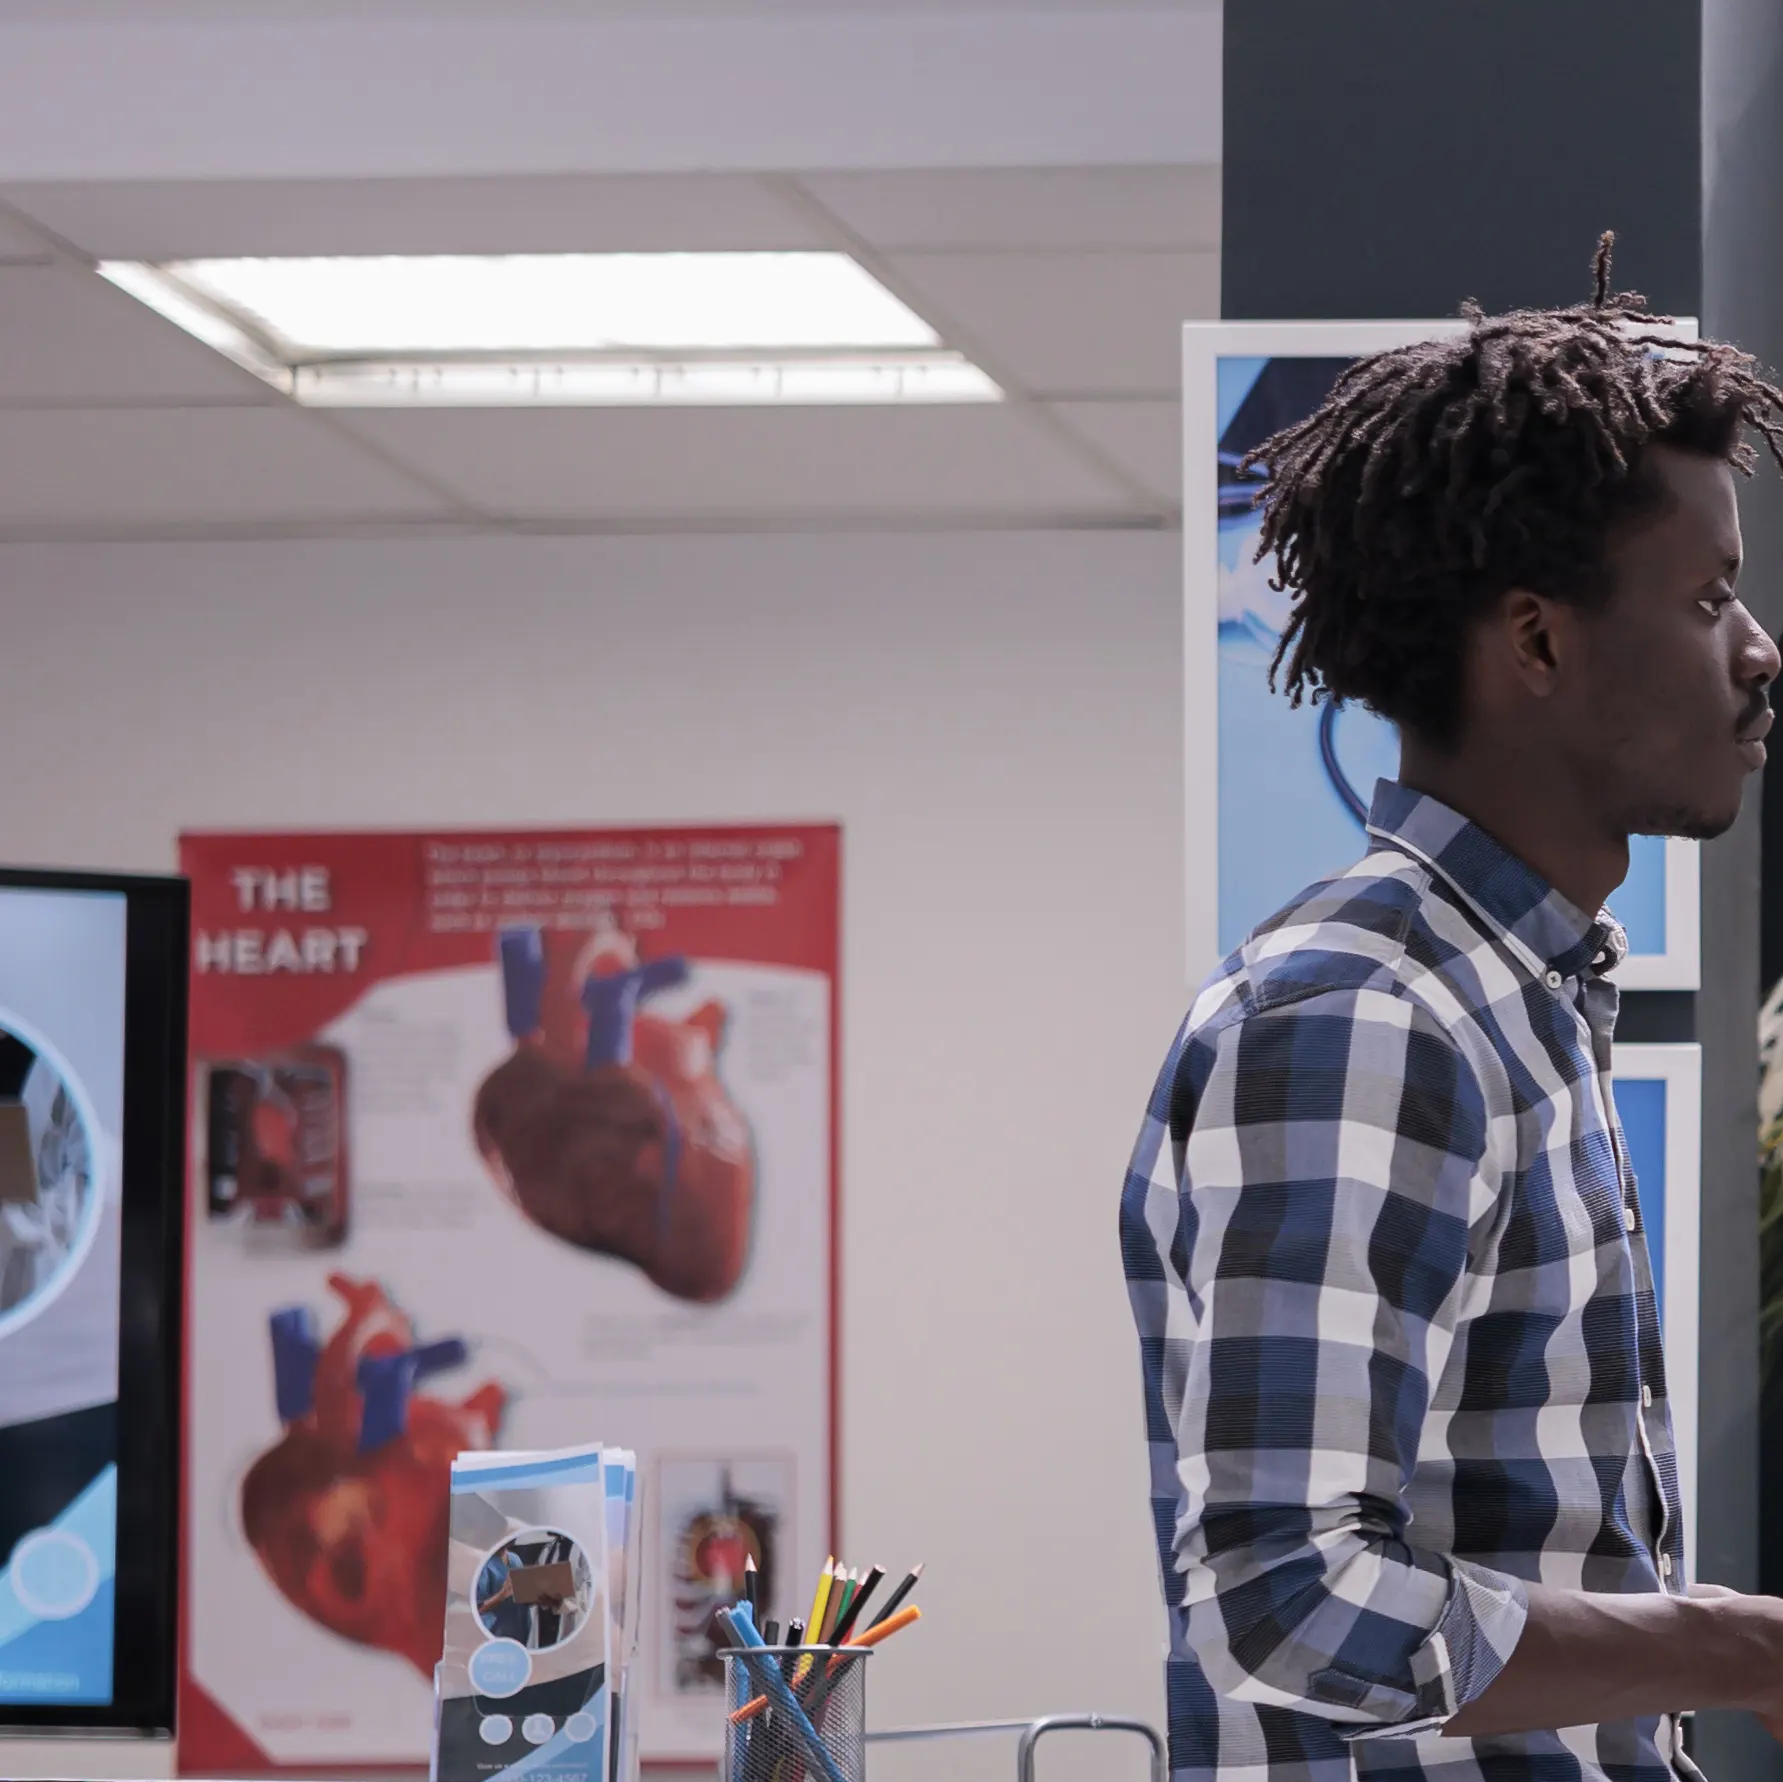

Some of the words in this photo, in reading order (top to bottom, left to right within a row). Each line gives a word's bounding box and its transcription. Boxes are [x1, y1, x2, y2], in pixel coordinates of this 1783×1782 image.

[231, 864, 332, 913] THE
[196, 926, 368, 974] HEART
[483, 1671, 516, 1683] CALL
